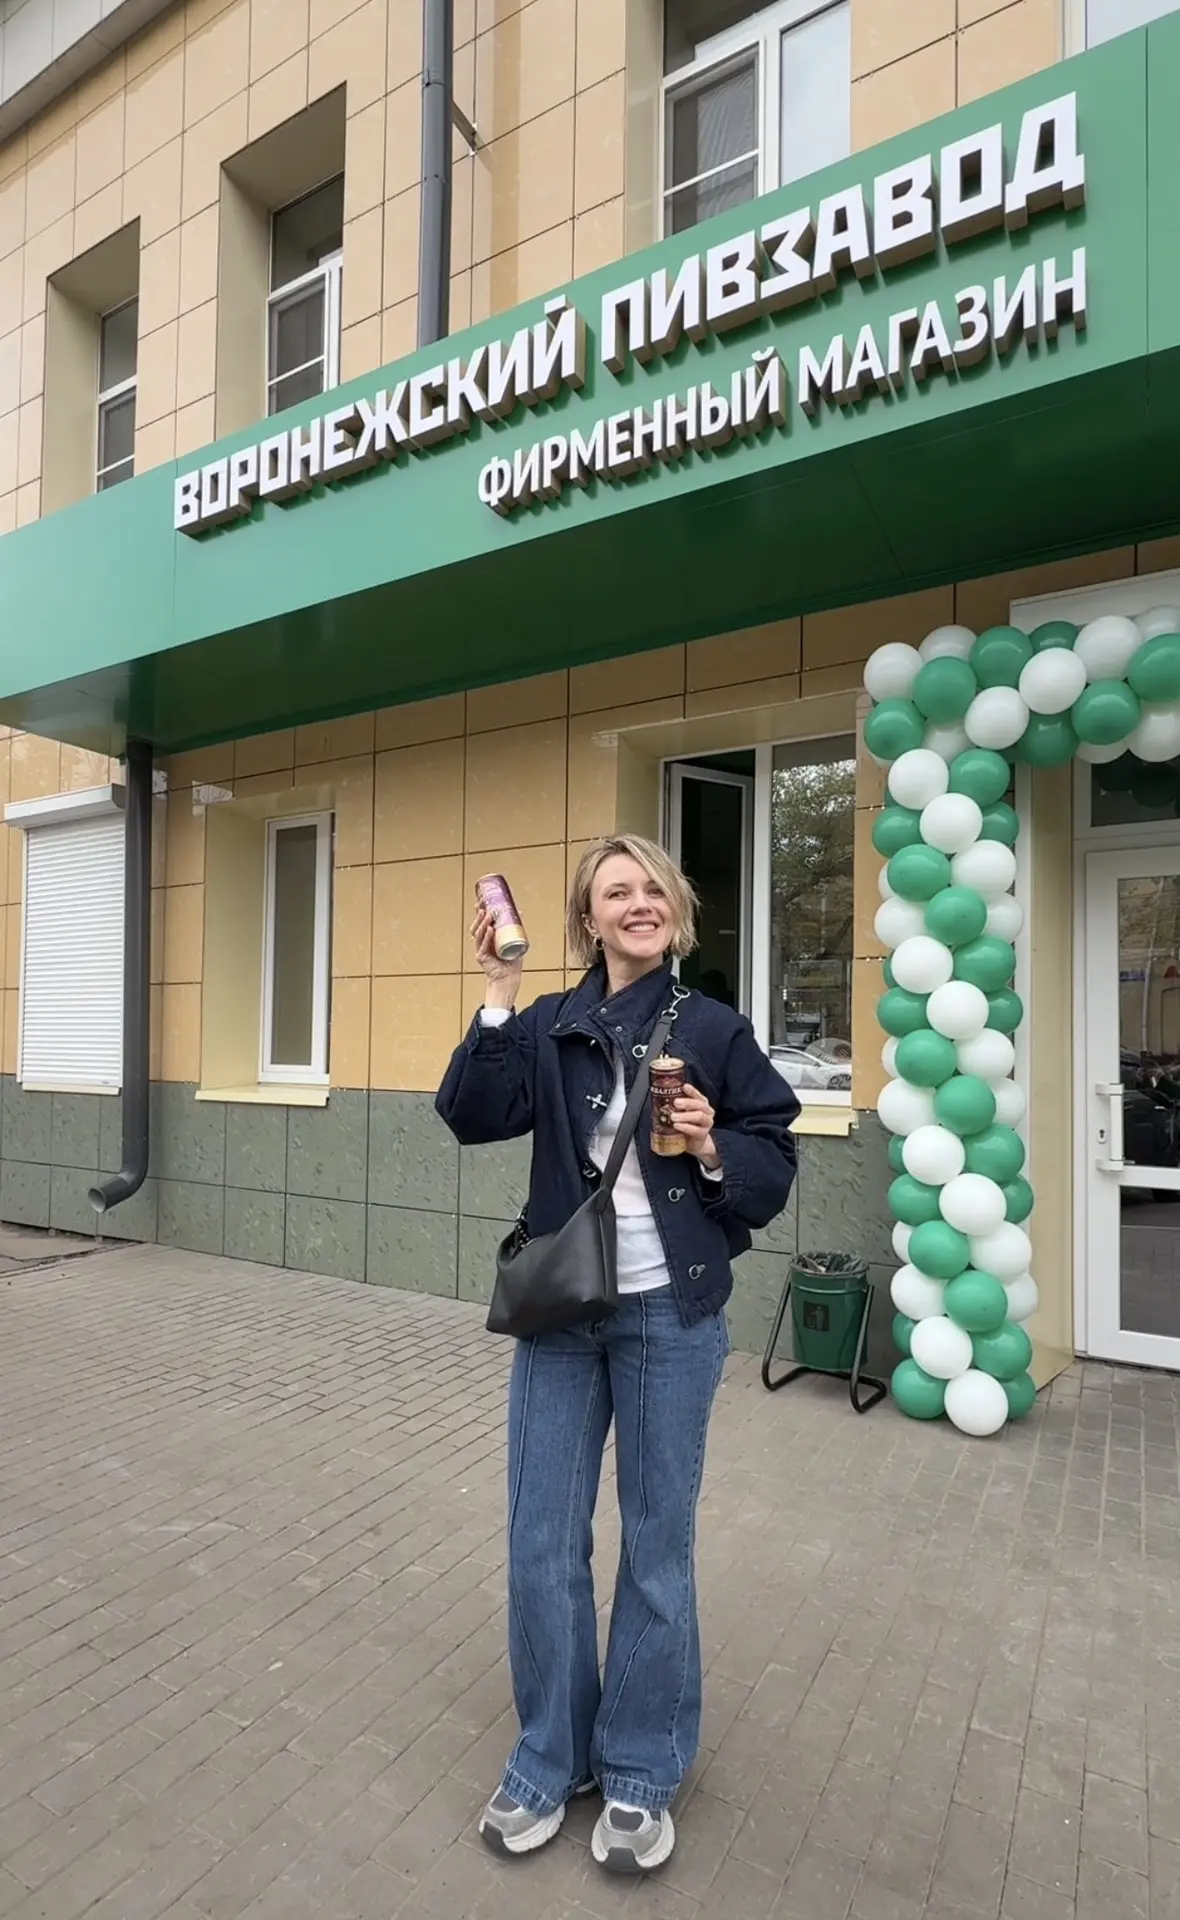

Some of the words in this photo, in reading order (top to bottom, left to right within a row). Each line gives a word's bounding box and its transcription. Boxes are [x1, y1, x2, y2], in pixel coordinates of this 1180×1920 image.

[174, 294, 577, 531] ВОРОНЕЖСКИЙ
[600, 91, 1086, 366] ПИВЗАВОД
[478, 346, 781, 507] ФИРМЕННЫЙ
[798, 246, 1087, 405] МАГАЗИН
